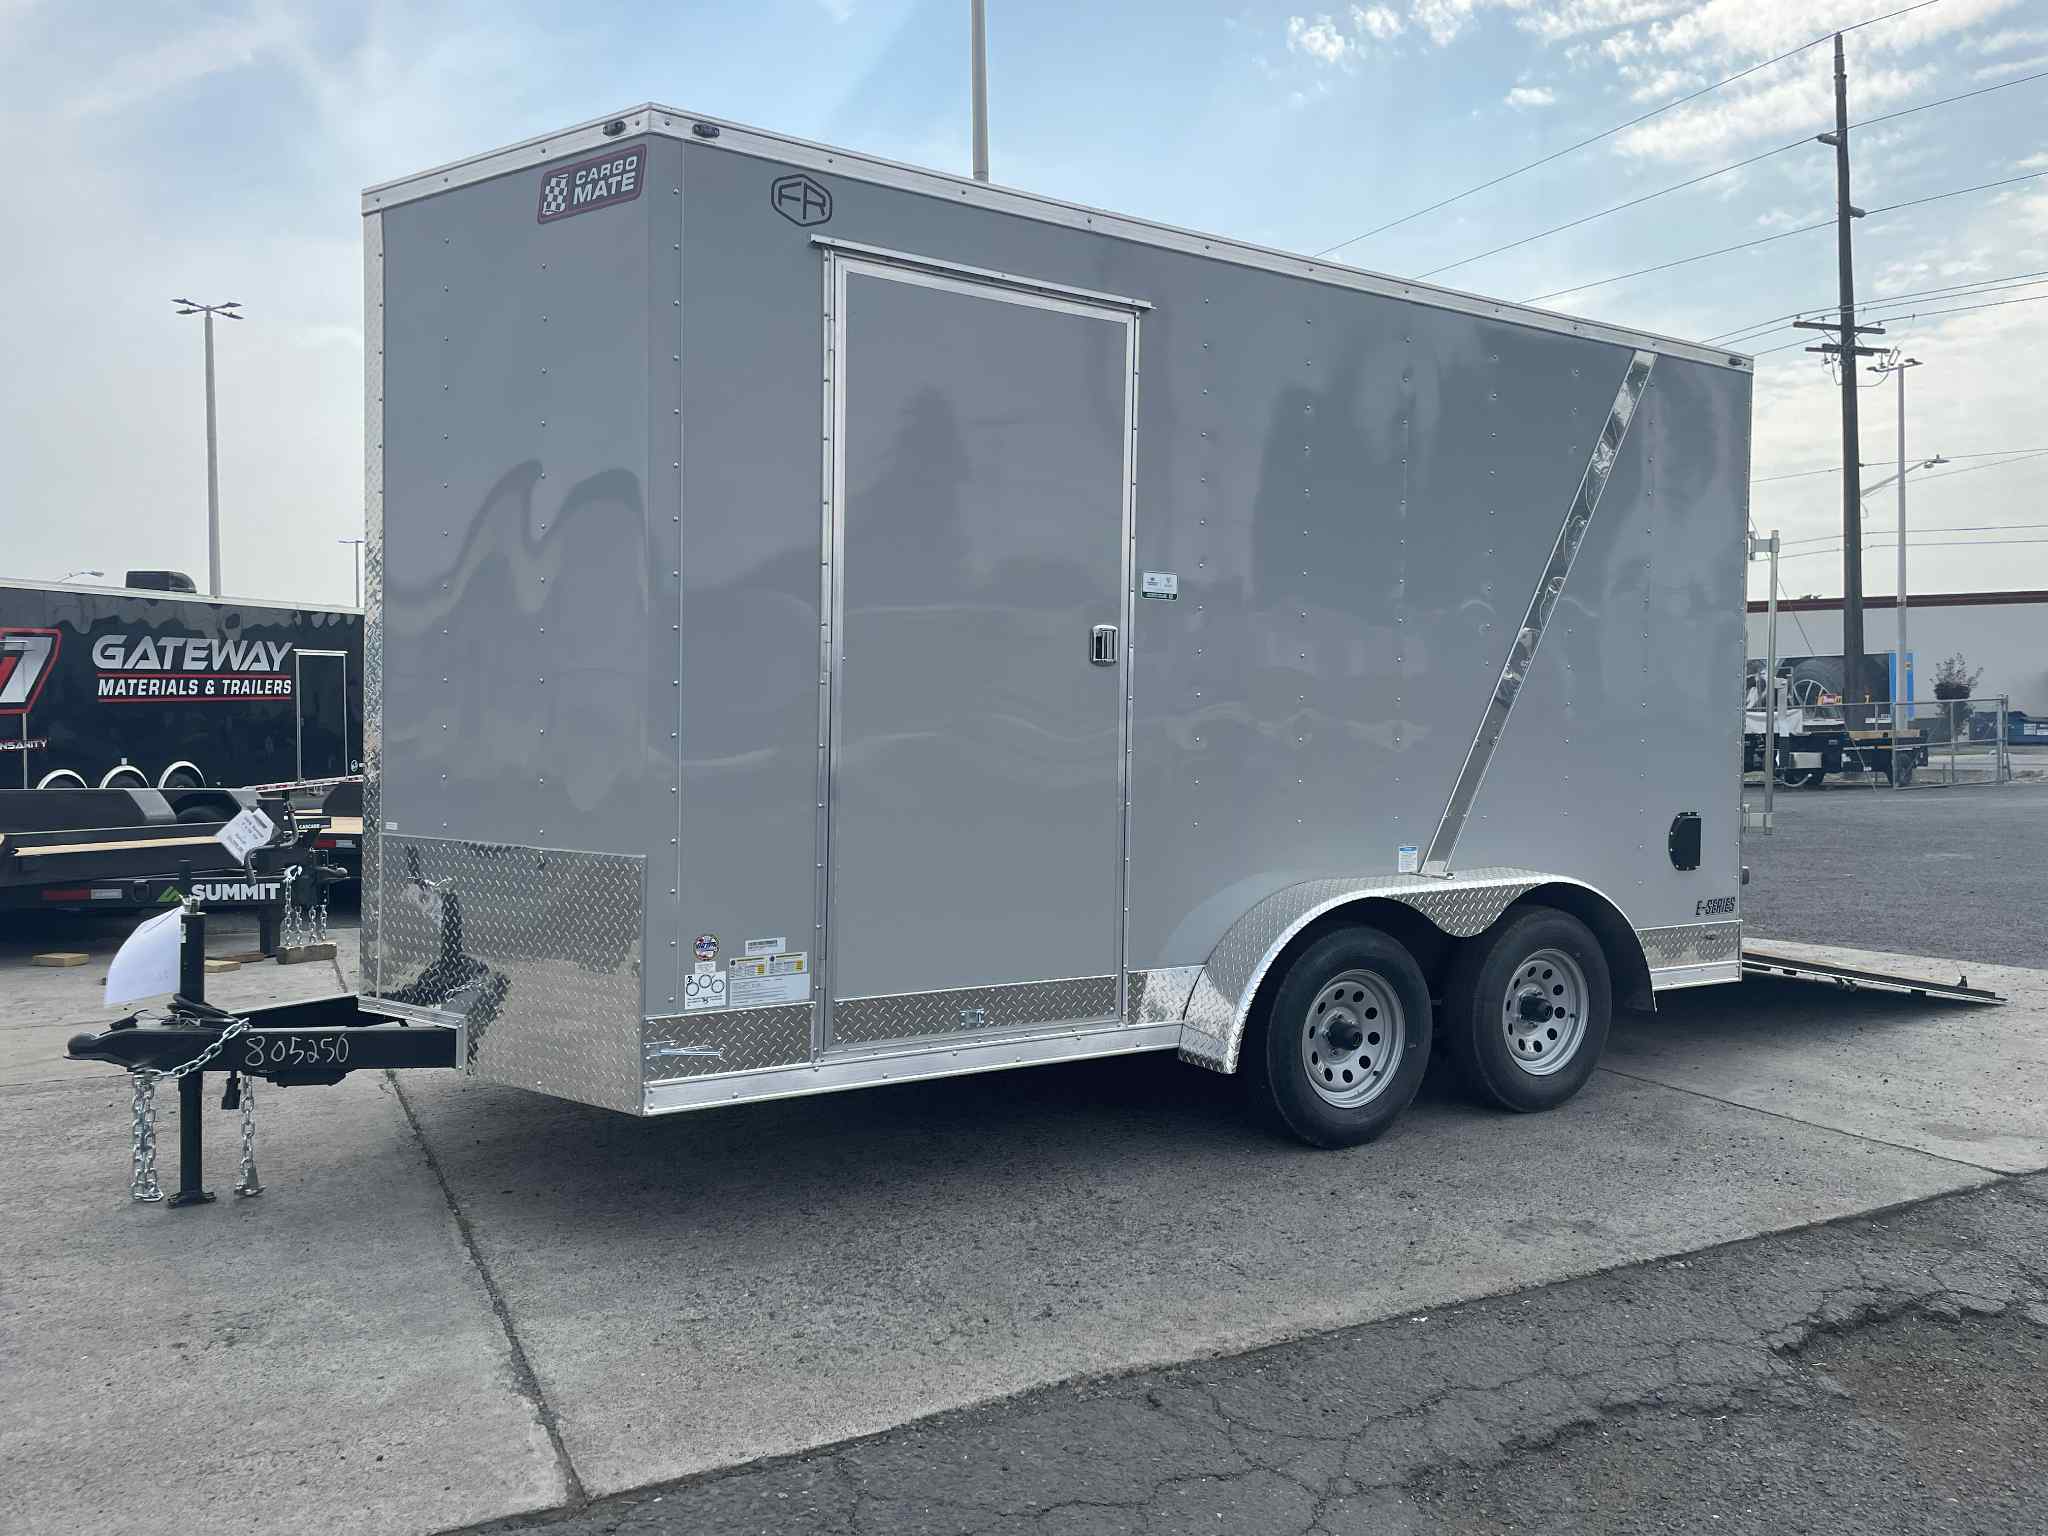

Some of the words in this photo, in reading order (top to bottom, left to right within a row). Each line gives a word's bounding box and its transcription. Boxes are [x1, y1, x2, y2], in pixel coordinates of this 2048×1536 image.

[575, 155, 638, 185] CARGO
[573, 172, 635, 205] MATE
[92, 634, 294, 672] GATEWAY
[98, 678, 198, 697] MATERIALS
[205, 679, 216, 696] &
[222, 678, 292, 696] TRAILERS
[191, 882, 281, 901] SUMMIT
[1695, 897, 1736, 916] E-SERIES
[244, 1033, 350, 1067] 805250
